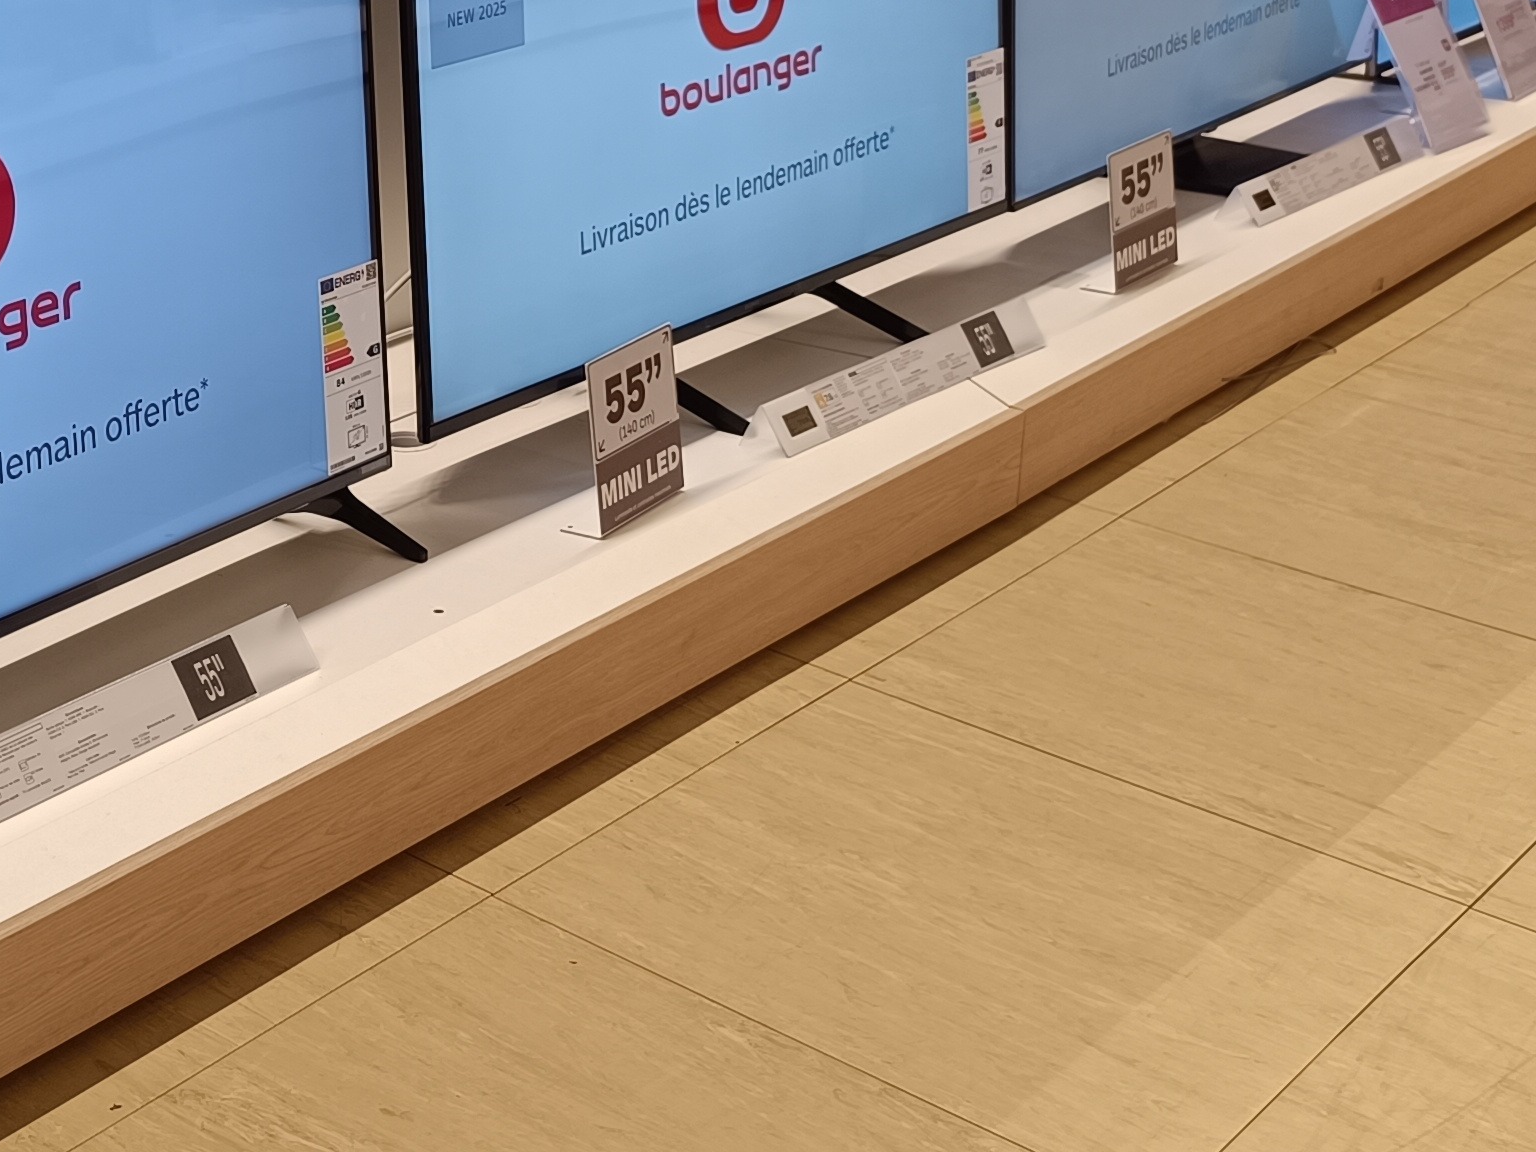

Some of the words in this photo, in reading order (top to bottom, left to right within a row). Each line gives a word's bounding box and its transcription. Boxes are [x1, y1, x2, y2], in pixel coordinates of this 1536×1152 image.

[447, 8, 475, 29] NEW
[478, 0, 507, 22] 2025
[1107, 41, 1163, 78] Livraison
[1165, 30, 1188, 55] dès
[1190, 24, 1201, 46] le
[1203, 5, 1262, 41] lendemain
[659, 44, 823, 118] boulanger
[580, 205, 669, 256] Livraison
[674, 191, 710, 222] dès
[715, 183, 731, 208] le
[736, 149, 829, 201] lendemain
[1116, 239, 1147, 272] MINI
[1150, 226, 1175, 256] LED
[619, 417, 638, 442] (140
[639, 409, 655, 430] cm)
[600, 463, 642, 510] MINI
[646, 444, 680, 484] LED
